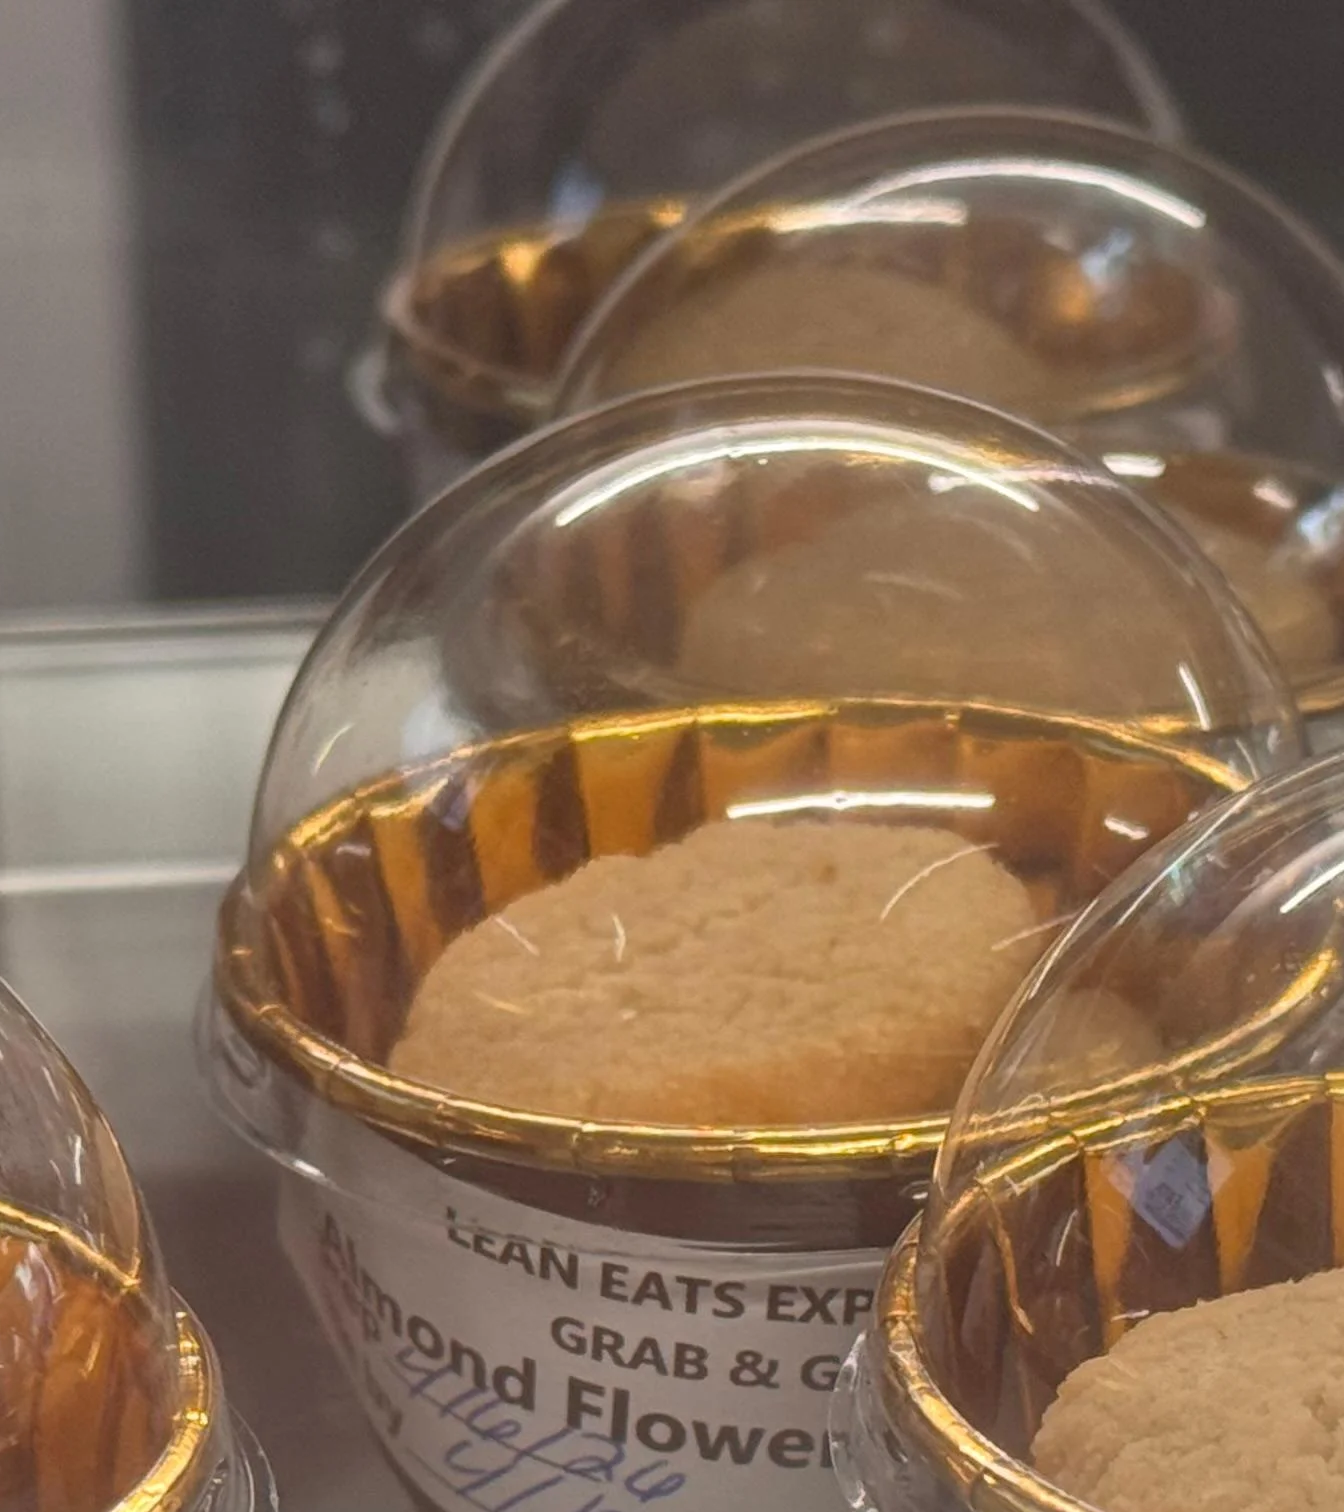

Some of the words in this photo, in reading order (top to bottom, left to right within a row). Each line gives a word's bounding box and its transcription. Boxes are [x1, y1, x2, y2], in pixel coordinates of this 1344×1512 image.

[446, 1206, 580, 1290] LEAN
[599, 1263, 746, 1321] EATS
[766, 1284, 874, 1327] EXP
[320, 1212, 536, 1413] Almond
[565, 1375, 850, 1471] Flower
[550, 1315, 709, 1382] GRAB
[729, 1348, 781, 1391] &
[800, 1354, 844, 1393] G
